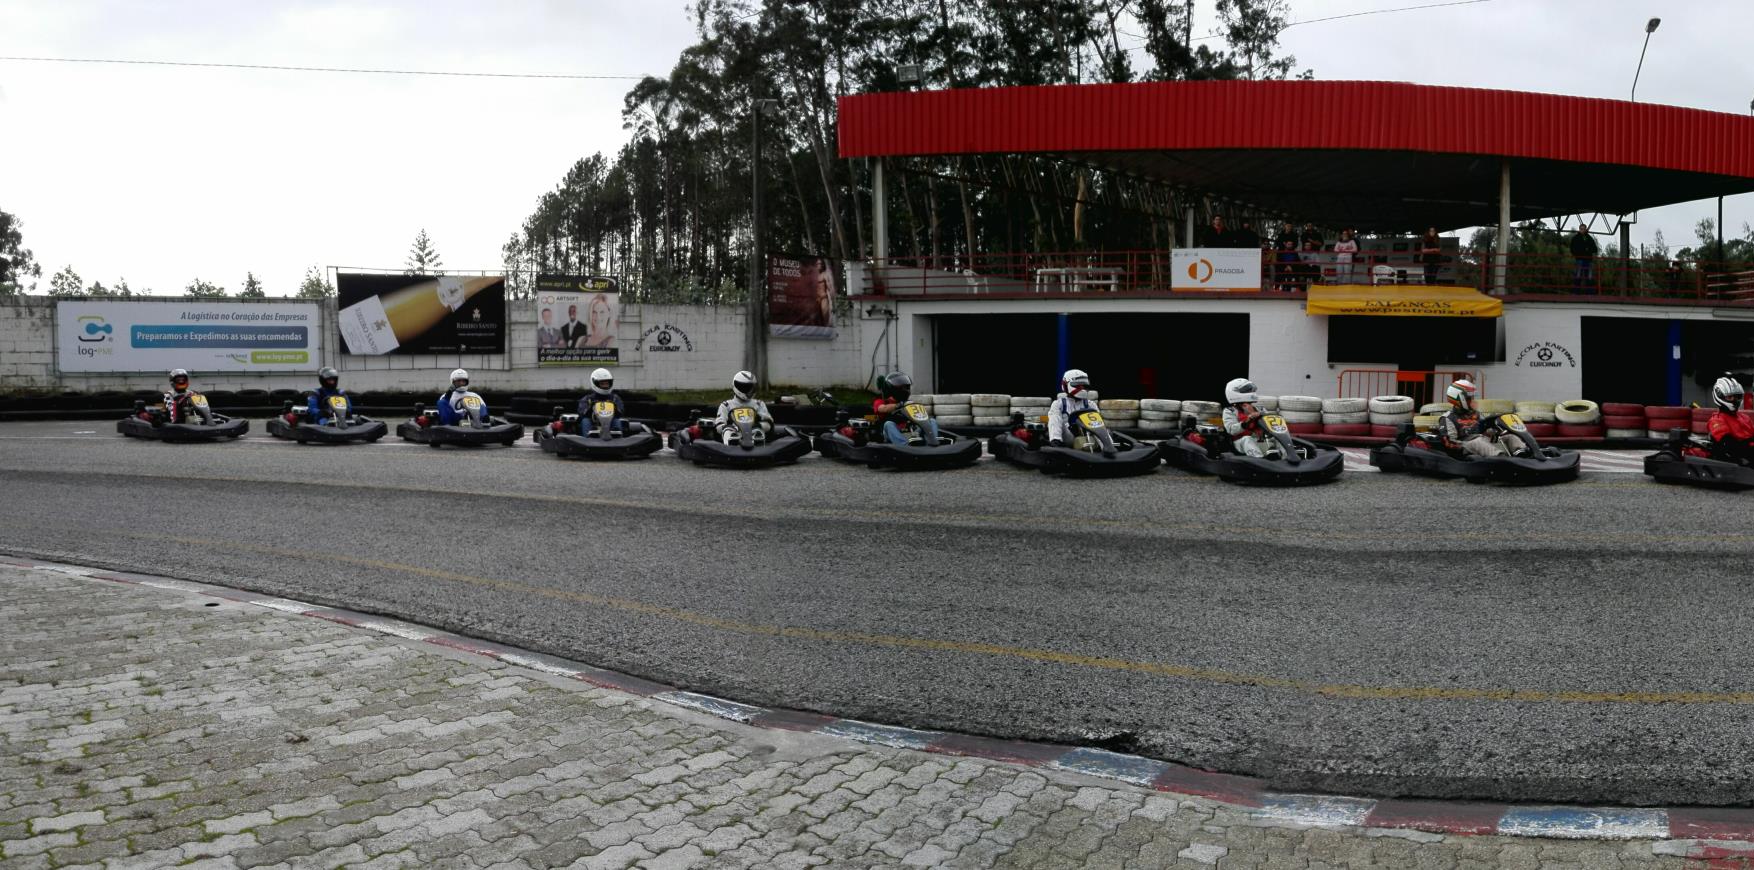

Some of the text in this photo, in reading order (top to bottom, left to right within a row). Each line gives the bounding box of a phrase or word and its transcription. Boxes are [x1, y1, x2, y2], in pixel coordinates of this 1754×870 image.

[780, 259, 800, 268] MUSEU
[773, 267, 801, 278] DE TODOS
[594, 281, 609, 290] apri
[186, 312, 219, 322] Logística
[231, 312, 260, 322] Coração
[275, 313, 308, 322] Empresas
[136, 332, 182, 341] Preparamos
[190, 332, 229, 342] Expedimos
[257, 332, 302, 340] encomendas
[1515, 341, 1576, 368] ESCOLA KARTING
